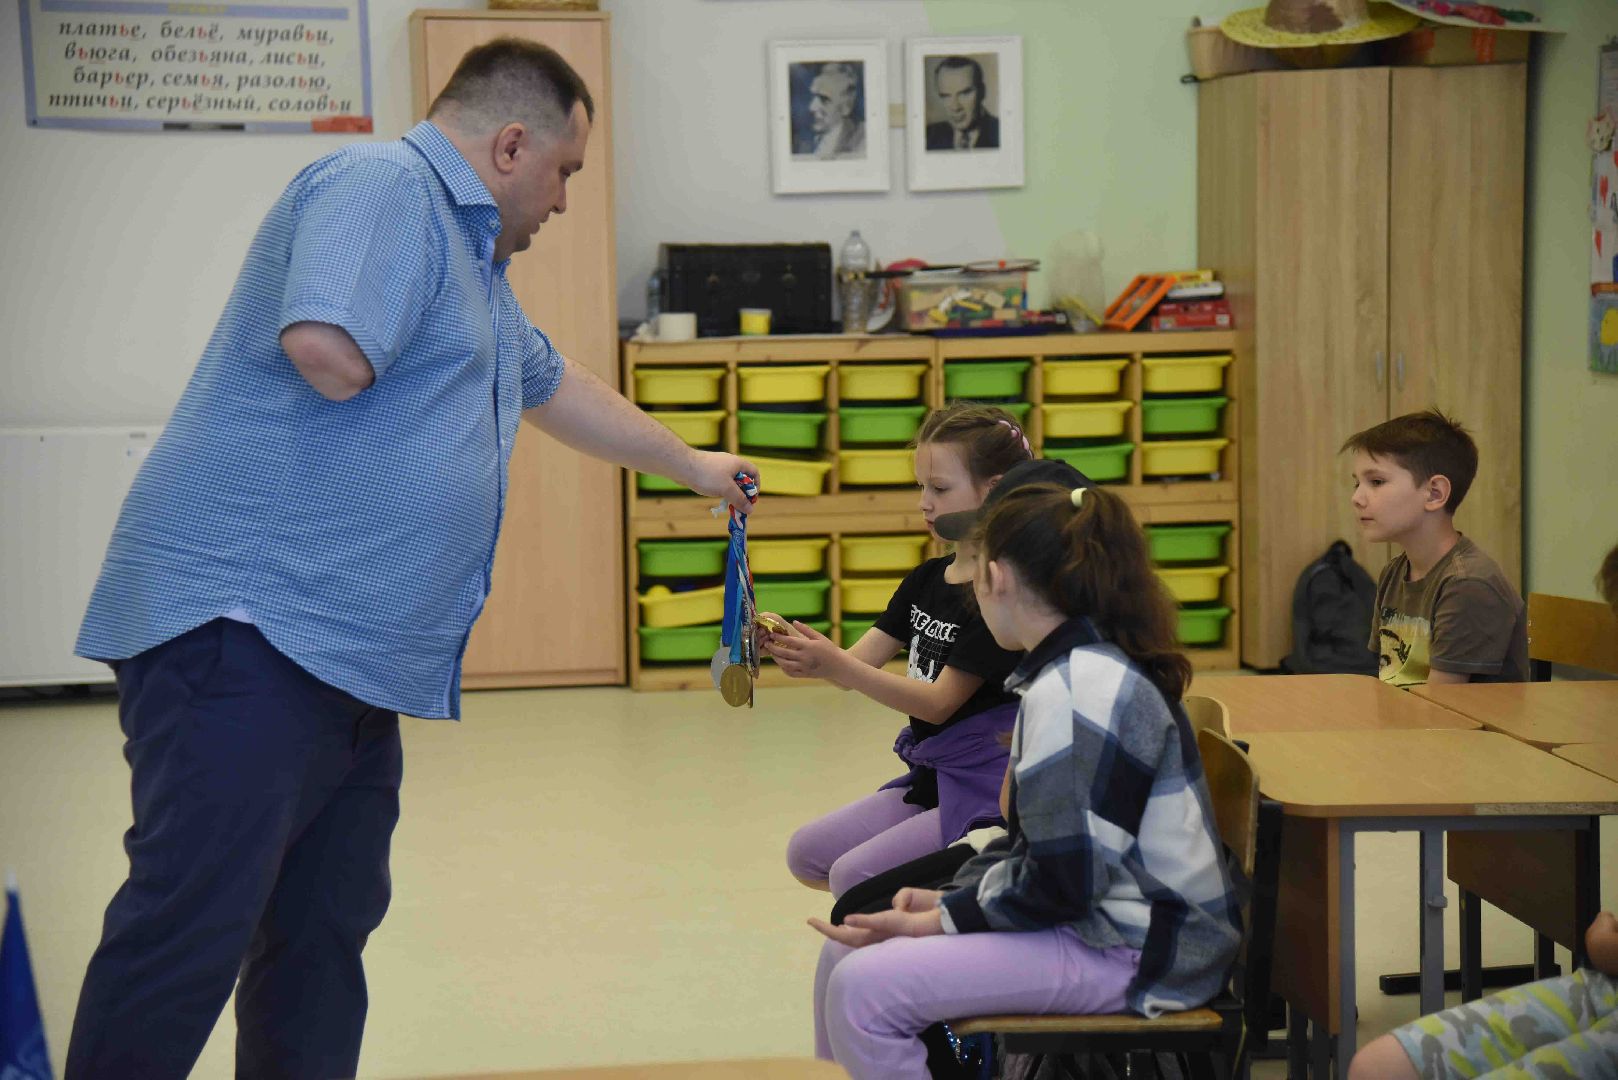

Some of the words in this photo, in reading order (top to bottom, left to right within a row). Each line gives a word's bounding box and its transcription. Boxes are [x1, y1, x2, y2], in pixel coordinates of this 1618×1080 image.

[59, 22, 147, 39] платье,
[160, 20, 224, 40] бельё,
[236, 23, 334, 46] муравьи,
[65, 42, 136, 62] вьюга,
[151, 44, 254, 66] обезьяна,
[260, 51, 326, 67] лисьи,
[73, 65, 155, 90] барьер,
[162, 70, 230, 88] семья,
[236, 73, 331, 92] разолью,
[48, 94, 139, 111] птичьи,
[146, 92, 261, 114] серьёзный,
[268, 94, 352, 112] соловьи
